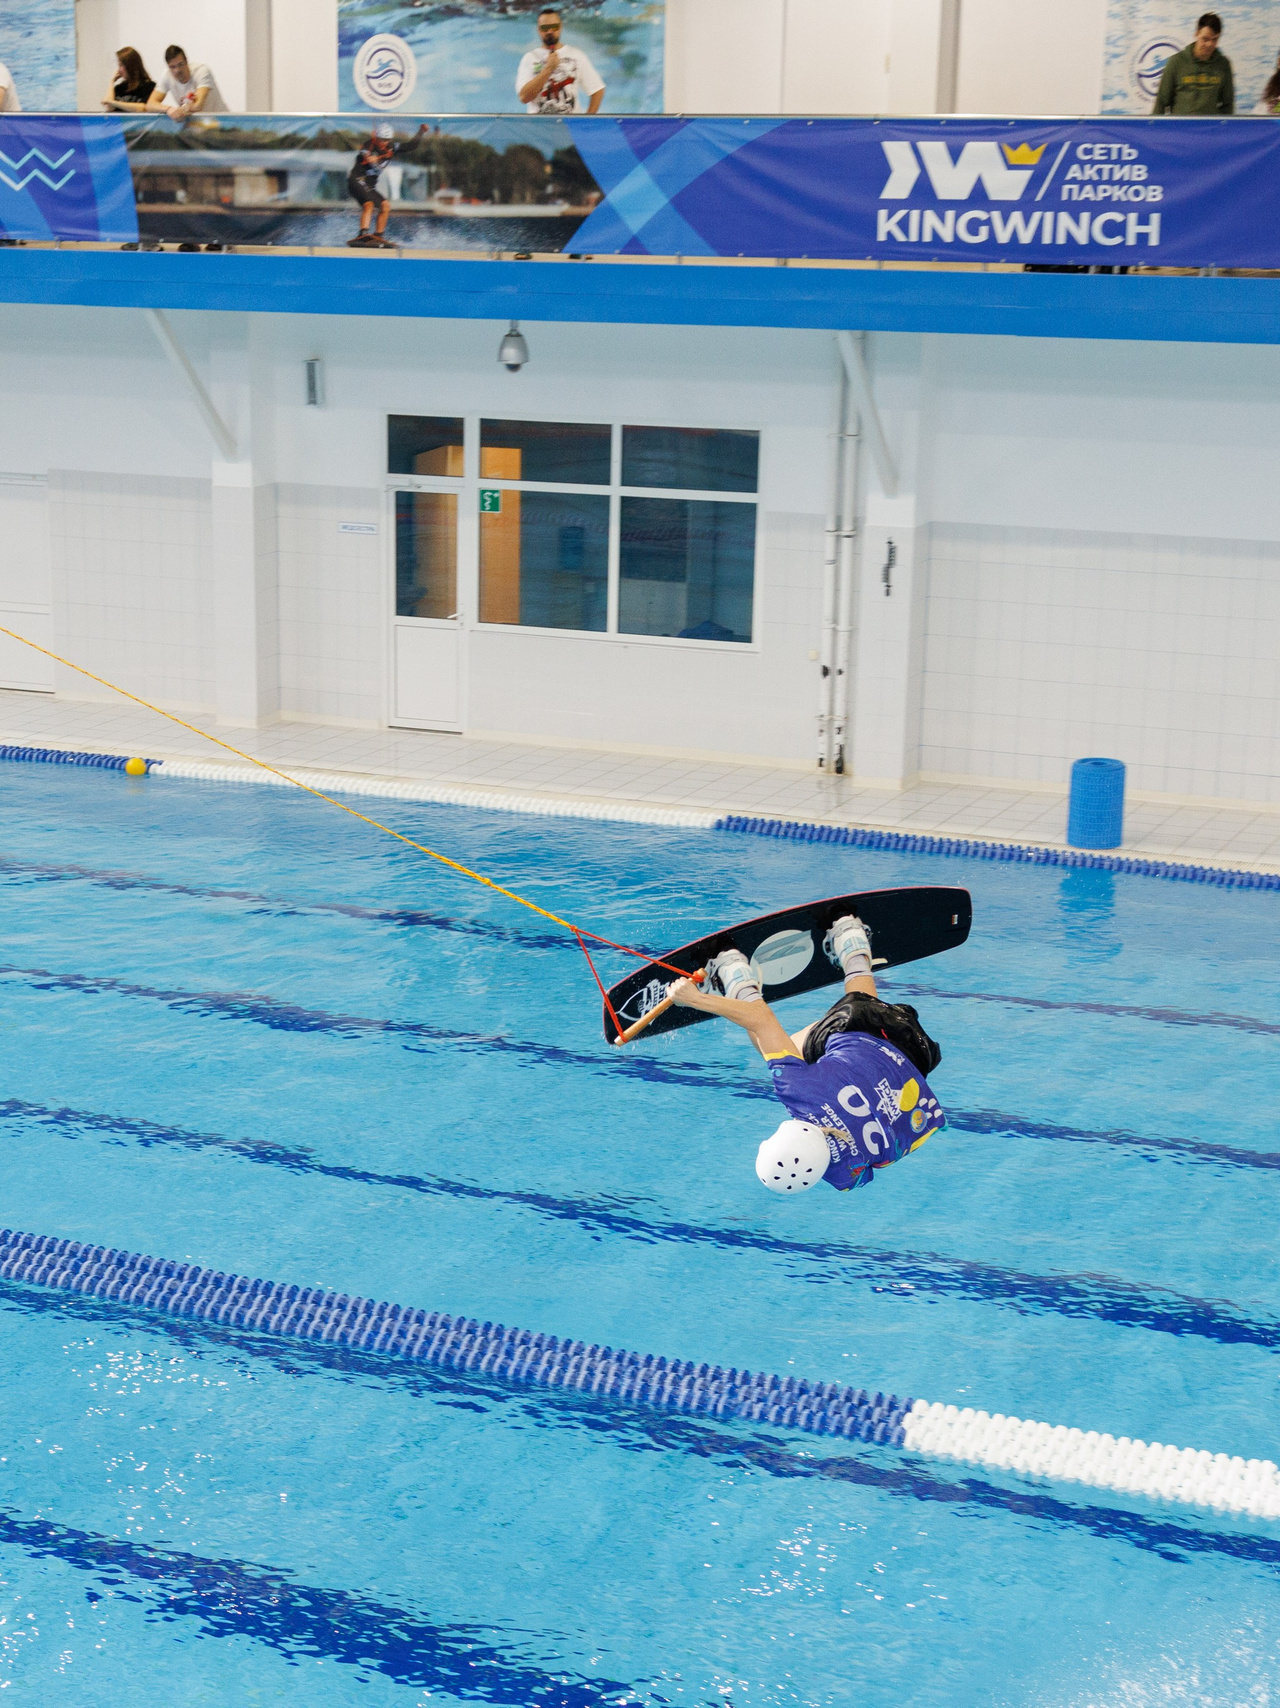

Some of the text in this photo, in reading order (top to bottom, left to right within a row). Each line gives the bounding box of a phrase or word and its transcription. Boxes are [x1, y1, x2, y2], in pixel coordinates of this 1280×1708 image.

[1075, 143, 1139, 161] СЕТЬ
[1064, 163, 1149, 182] АКТИВ
[1060, 184, 1164, 202] ПАРКОВ
[876, 208, 1162, 246] KINGWINCH
